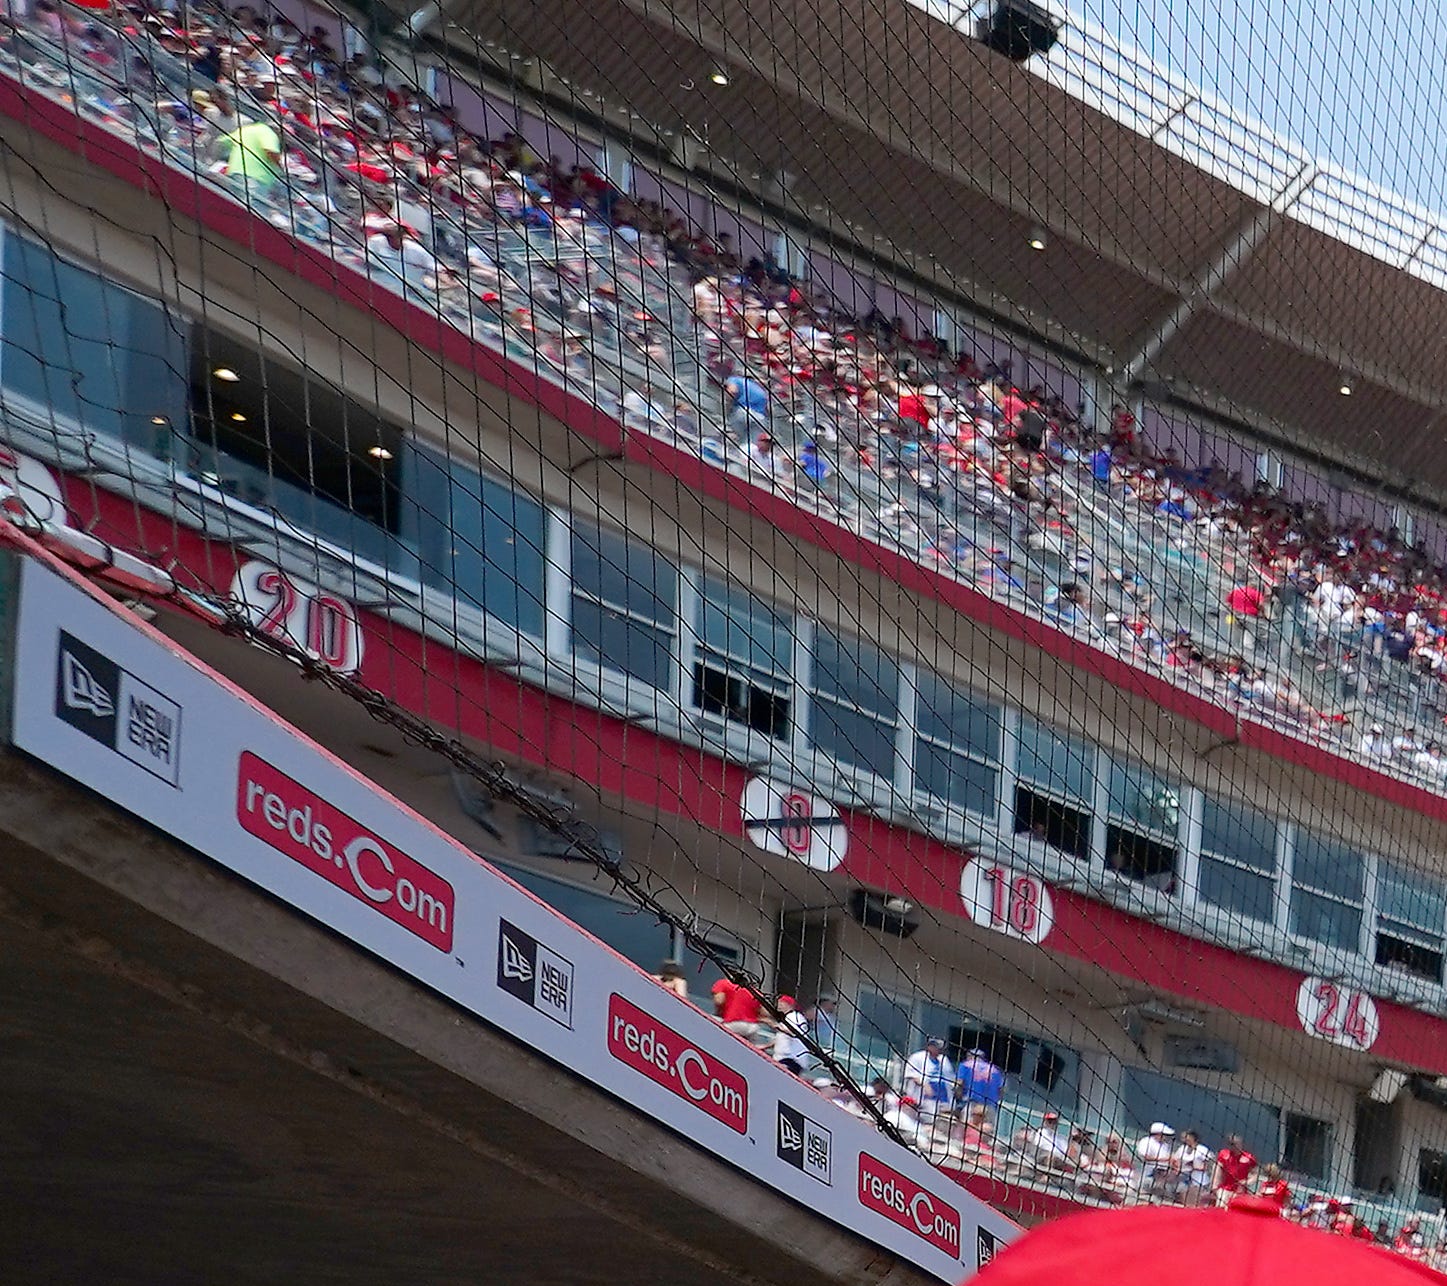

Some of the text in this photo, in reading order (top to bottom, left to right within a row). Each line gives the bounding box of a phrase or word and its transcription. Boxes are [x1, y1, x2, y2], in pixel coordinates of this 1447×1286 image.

[130, 694, 172, 738] NEW
[129, 719, 171, 765] ERA
[245, 778, 447, 934] reds.Com
[986, 867, 1039, 932] 18
[541, 959, 568, 992] NEW
[541, 979, 567, 1013] ERA
[1315, 983, 1370, 1047] 24
[612, 1013, 744, 1118] reds.Com
[808, 1130, 828, 1157] NEW
[808, 1147, 828, 1173] ERA
[862, 1168, 959, 1247] reds.Com
